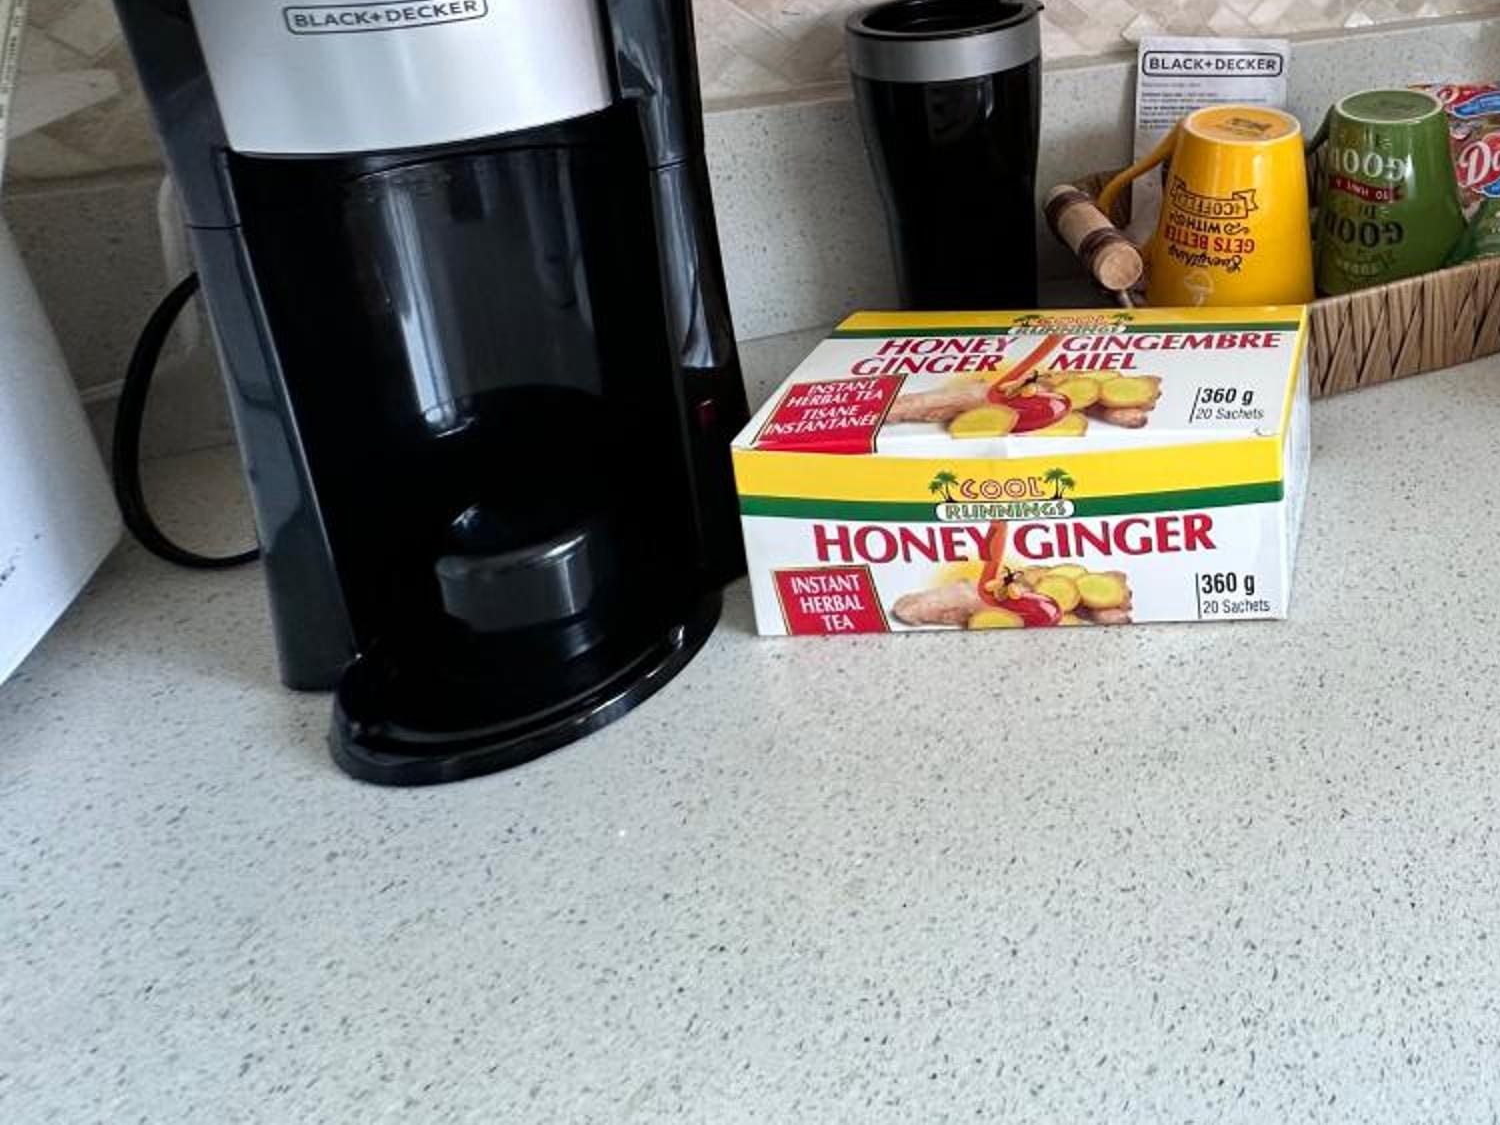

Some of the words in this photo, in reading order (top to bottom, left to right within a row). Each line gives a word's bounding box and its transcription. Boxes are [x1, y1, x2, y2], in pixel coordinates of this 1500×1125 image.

[294, 0, 478, 28] BLACK+DECKER
[1149, 58, 1277, 71] BLACK+DECKER
[1187, 216, 1221, 233] WITH
[1213, 236, 1255, 254] GETS
[877, 337, 1018, 355] HONEY
[1062, 332, 1281, 351] GINGEMBRE
[851, 355, 1004, 375] GINGER
[1049, 352, 1138, 371] MIEL
[807, 379, 877, 395] INSTANT
[1201, 387, 1237, 404] 360
[1241, 390, 1254, 406] g
[786, 395, 848, 408] HERBAL
[855, 390, 883, 401] TEA
[801, 405, 860, 420] TISANE
[1195, 407, 1213, 420] 20
[1215, 406, 1265, 420] Sachets
[959, 476, 1044, 500] COOL
[945, 501, 1066, 520] RUNNINGS
[813, 524, 995, 564] HONEY
[1013, 514, 1217, 561] GINGER
[791, 574, 861, 594] INSTANT
[1201, 572, 1237, 594] 360
[1244, 574, 1255, 596] g
[800, 594, 865, 615] HERBAL
[1202, 600, 1219, 614] 20
[1222, 599, 1271, 614] Sachets
[821, 614, 855, 632] TEA
